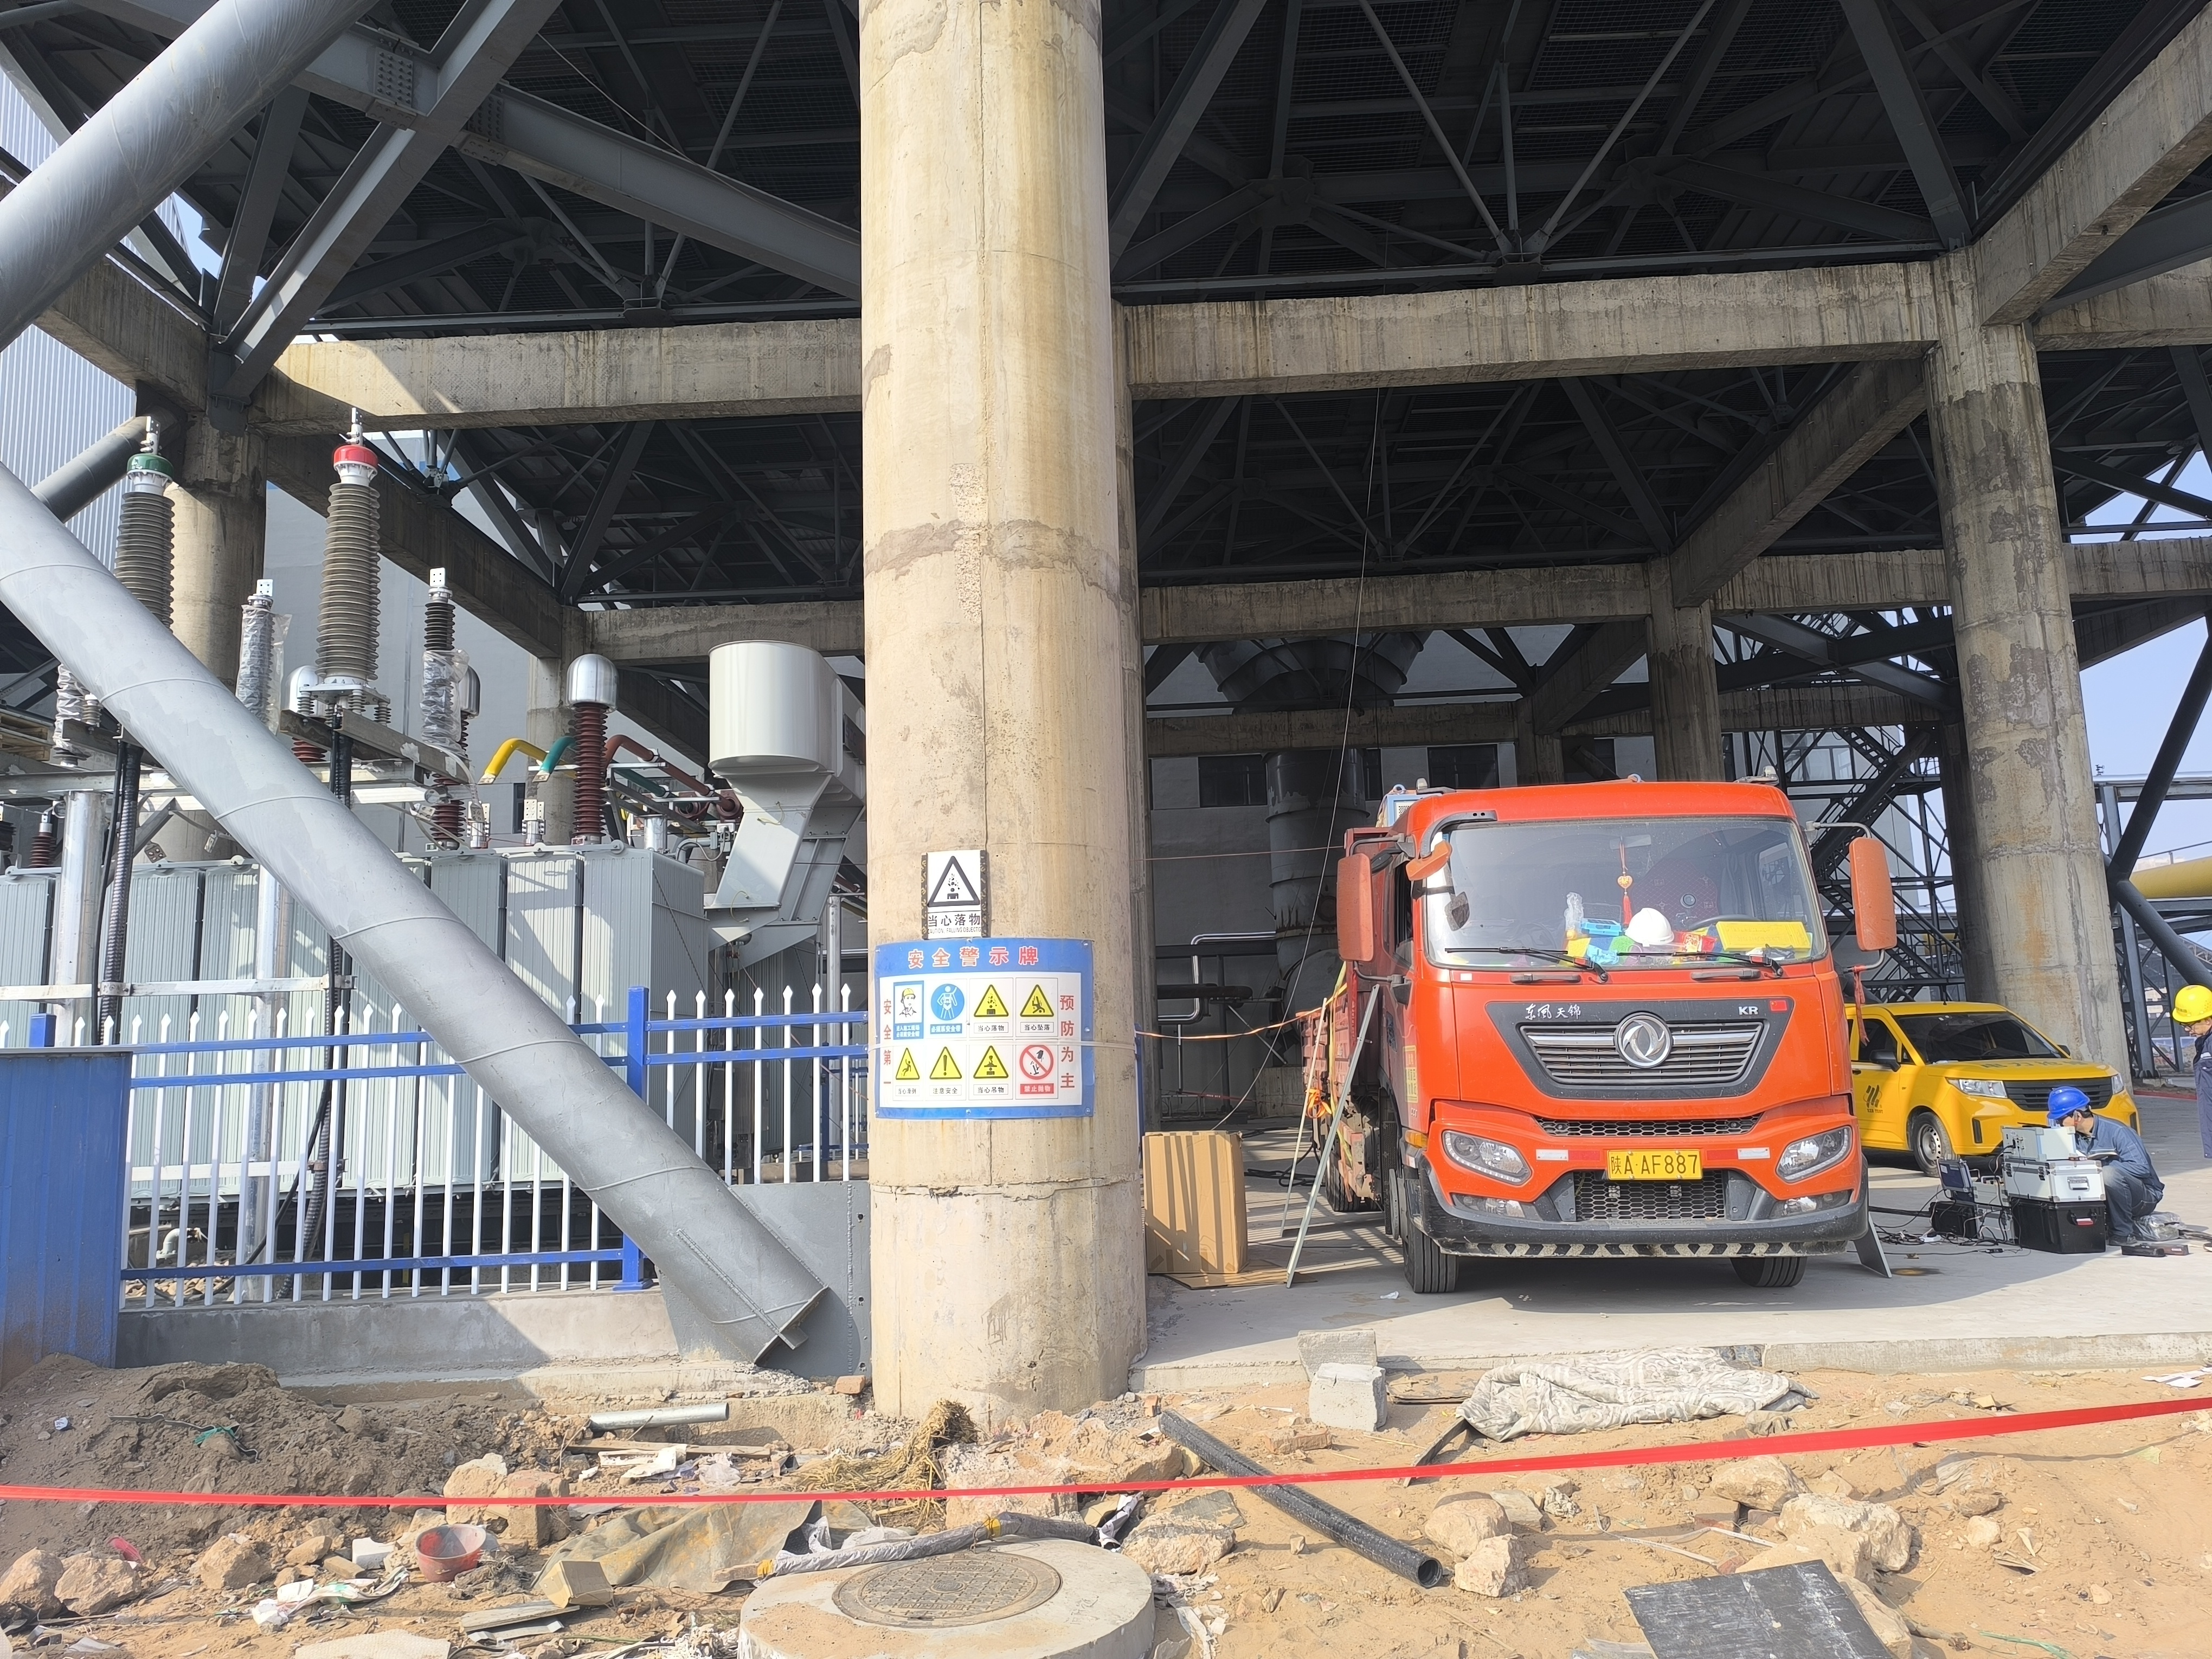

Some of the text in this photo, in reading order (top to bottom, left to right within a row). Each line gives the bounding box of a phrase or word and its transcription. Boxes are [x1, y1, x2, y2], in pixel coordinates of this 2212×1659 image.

[928, 913, 980, 927] 当心落物
[908, 946, 1038, 969] 安全警示牌
[1738, 1006, 1758, 1015] KR
[883, 999, 892, 1084] 安全第一
[1059, 995, 1075, 1088] 预防为主
[1611, 1154, 1697, 1175] 陕A·AF887
